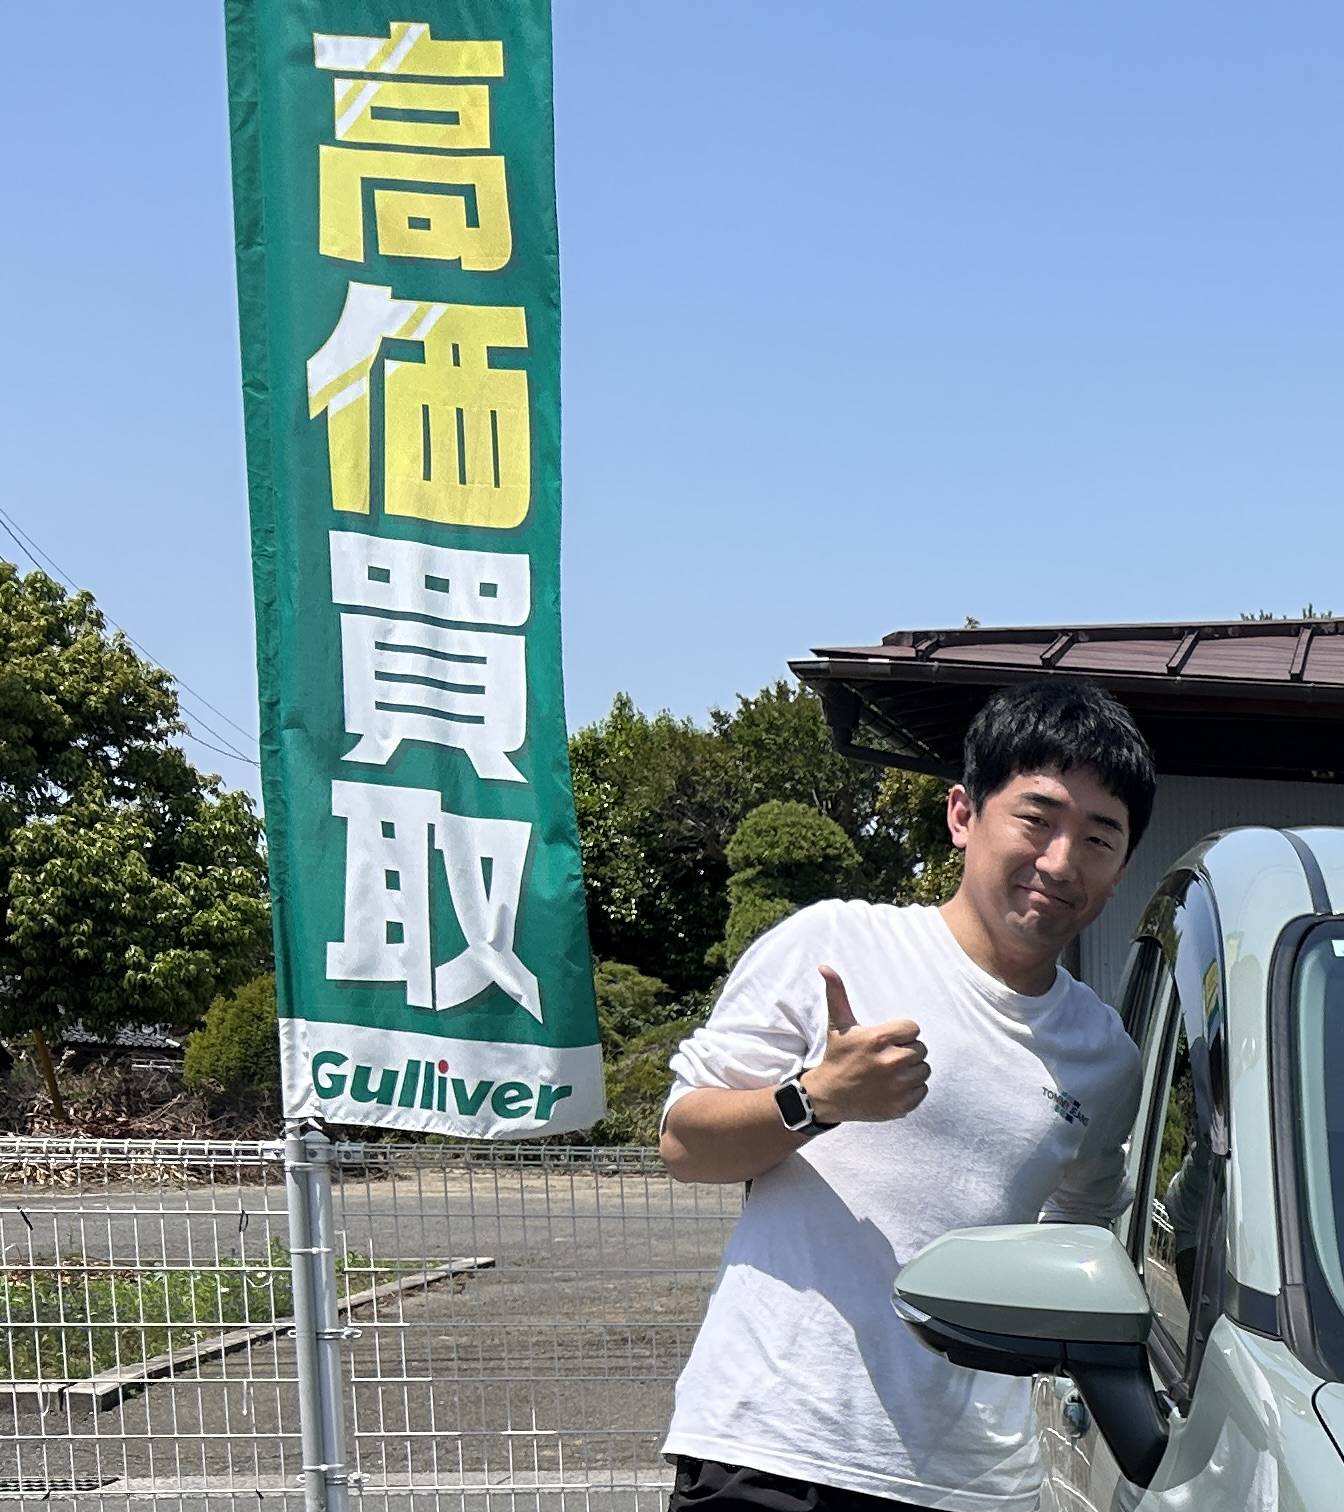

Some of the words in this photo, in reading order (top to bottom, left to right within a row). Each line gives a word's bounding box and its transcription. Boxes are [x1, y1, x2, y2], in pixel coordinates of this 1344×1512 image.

[306, 21, 543, 1024] 高価買取
[311, 1050, 572, 1121] Gulliver
